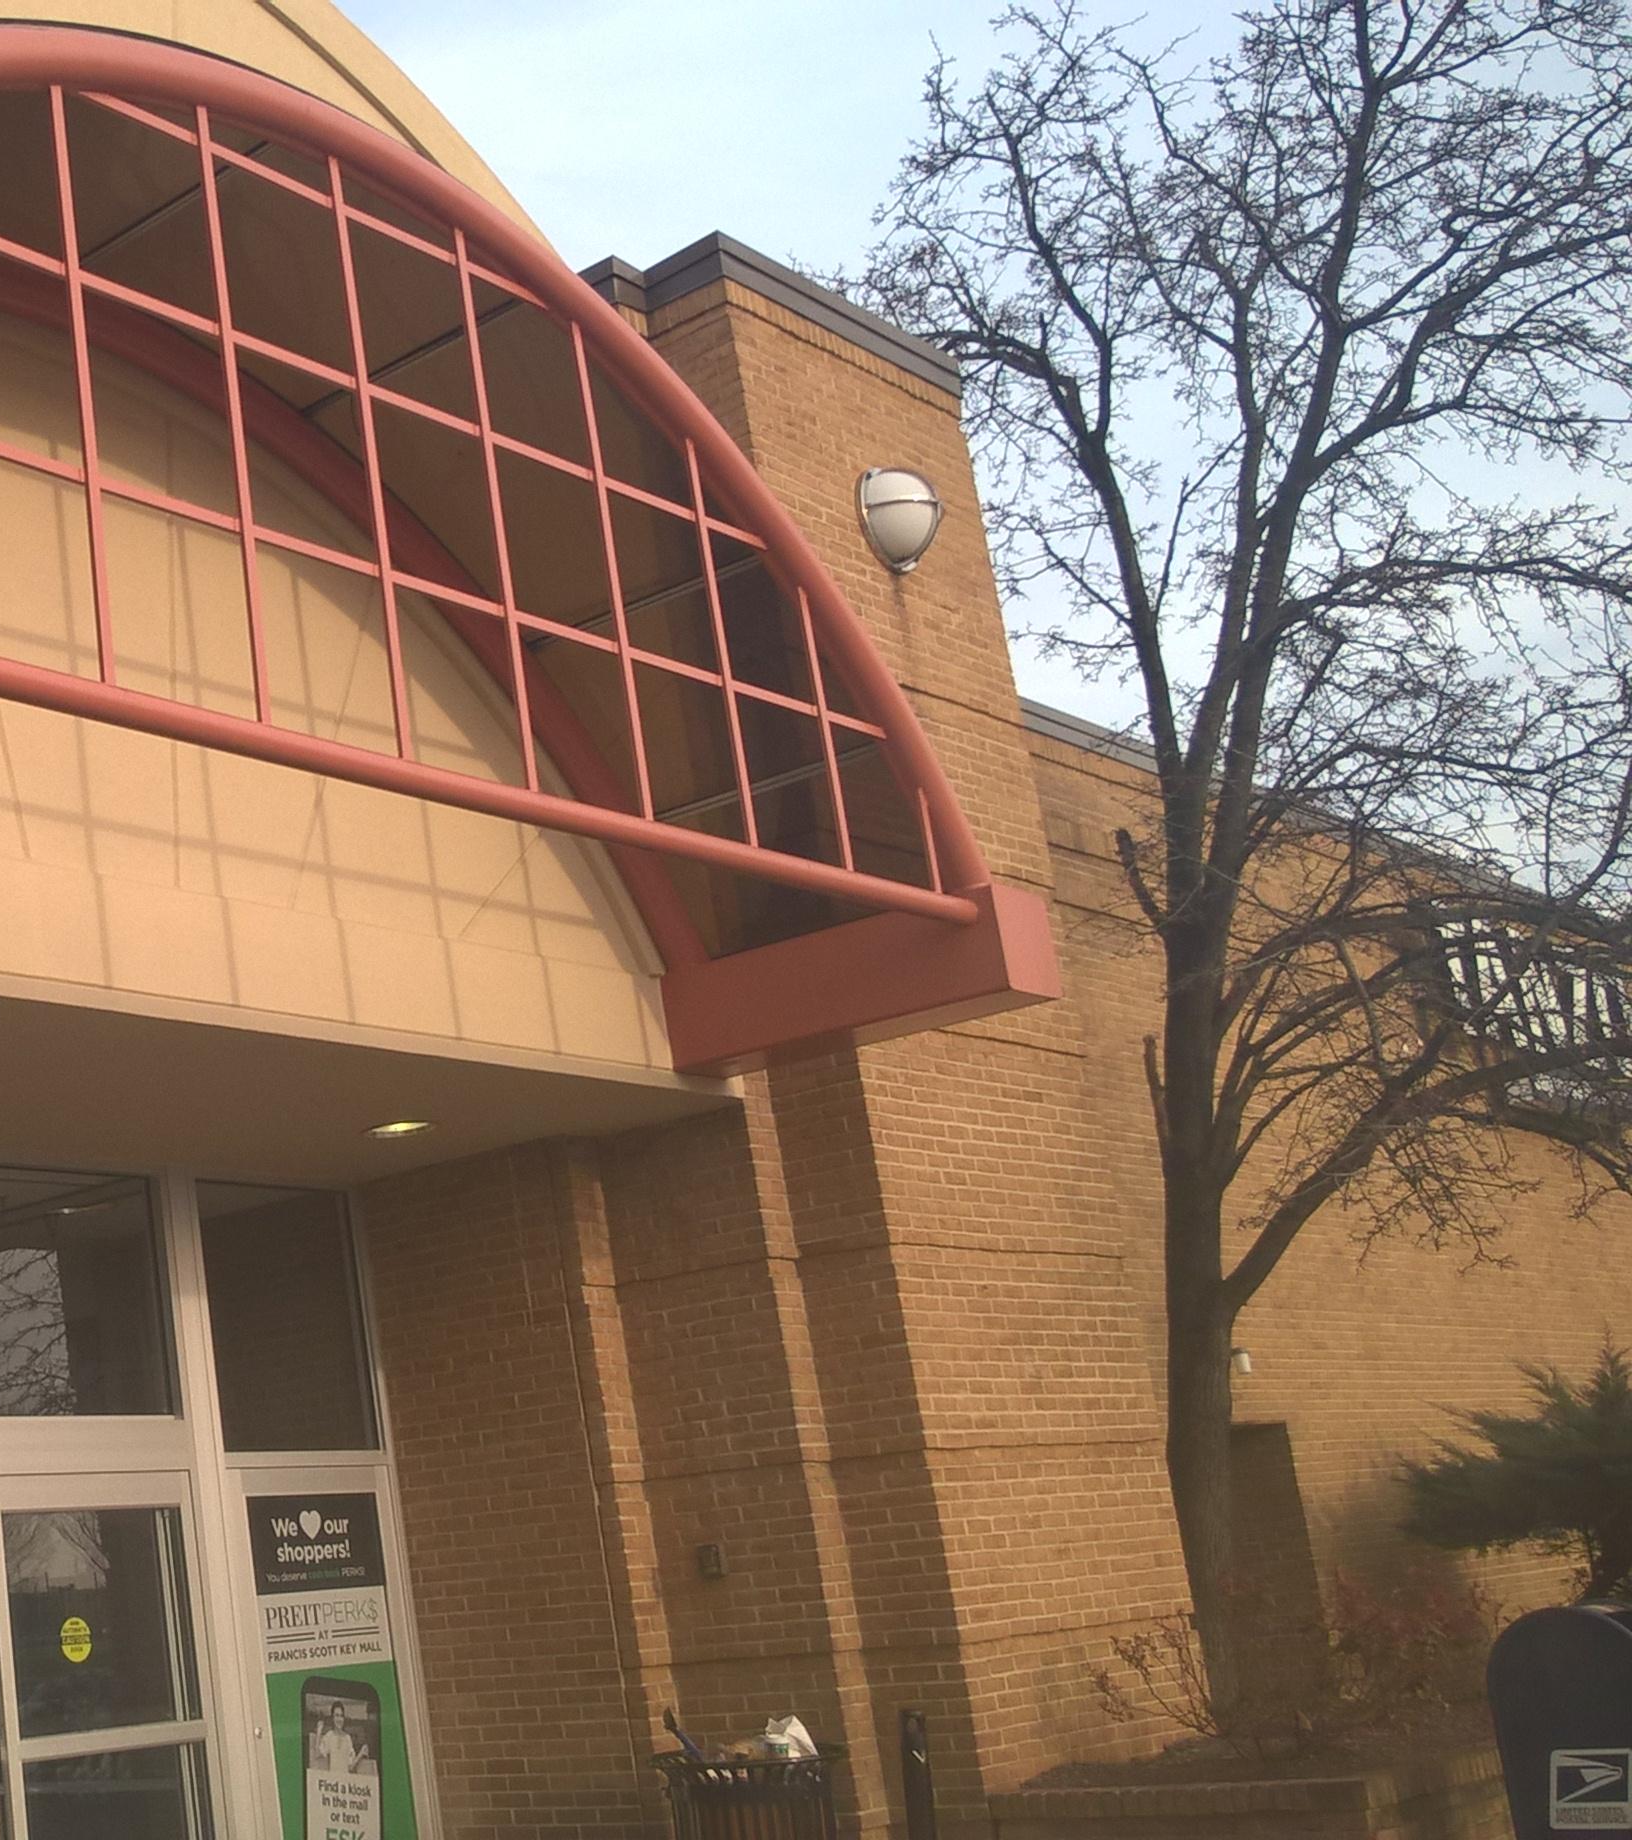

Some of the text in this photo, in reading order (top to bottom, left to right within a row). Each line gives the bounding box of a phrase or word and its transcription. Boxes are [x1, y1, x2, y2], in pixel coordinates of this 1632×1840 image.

[271, 1518, 349, 1538] We our
[276, 1539, 351, 1565] shoppers!
[318, 1630, 329, 1641] AT
[268, 1641, 383, 1662] FRANCIS SCOTT KEY MALL
[318, 1780, 372, 1797] Find a kiosk
[322, 1794, 369, 1811] in the mall
[330, 1812, 360, 1825] or text
